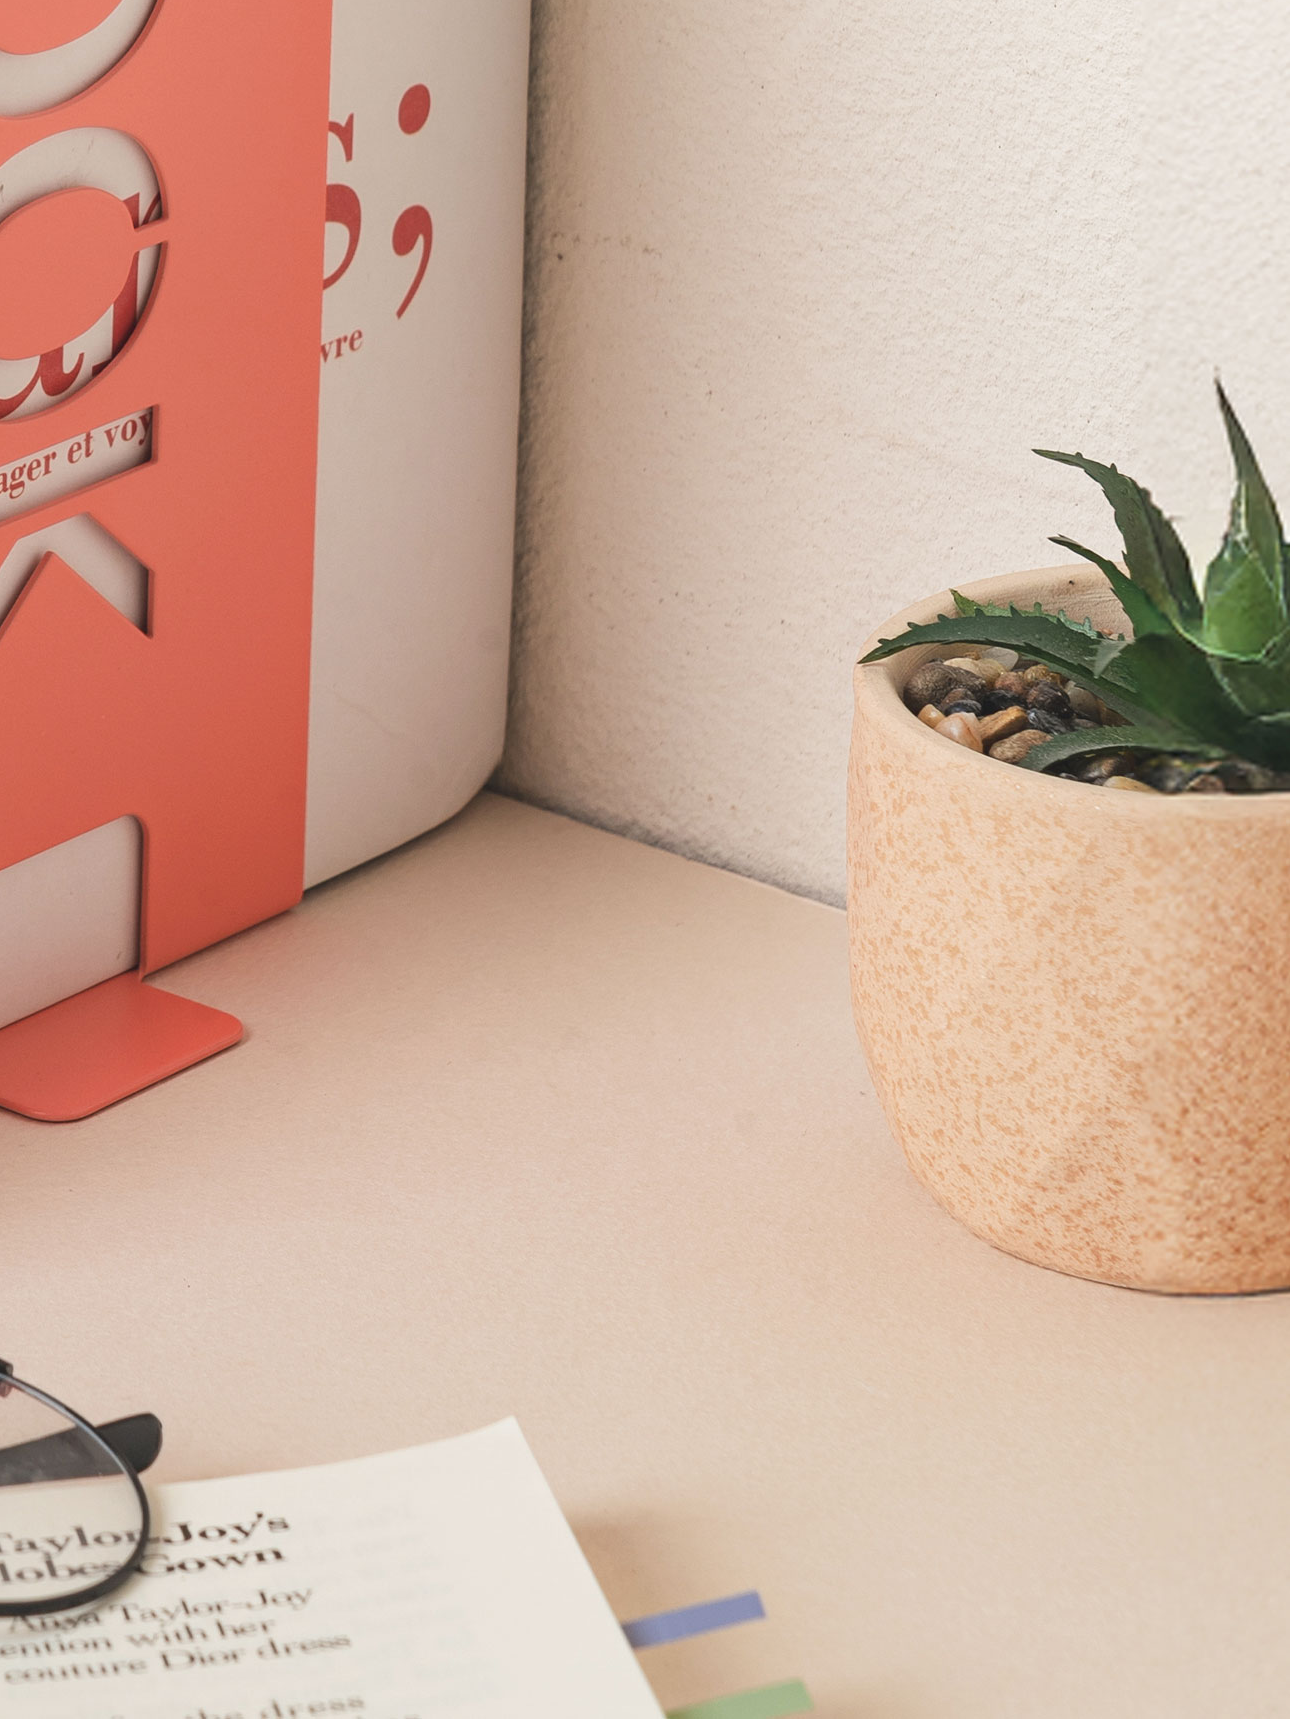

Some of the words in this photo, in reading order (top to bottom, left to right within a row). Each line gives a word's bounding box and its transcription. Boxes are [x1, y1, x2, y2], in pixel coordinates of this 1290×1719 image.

[67, 431, 94, 465] et
[136, 1547, 287, 1575] Gown
[111, 1588, 312, 1625] Taylor-Joy
[126, 1621, 210, 1649] with
[216, 1618, 278, 1640] her
[5, 1658, 149, 1684] couture
[160, 1645, 244, 1672] Dior
[256, 1634, 351, 1660] dress
